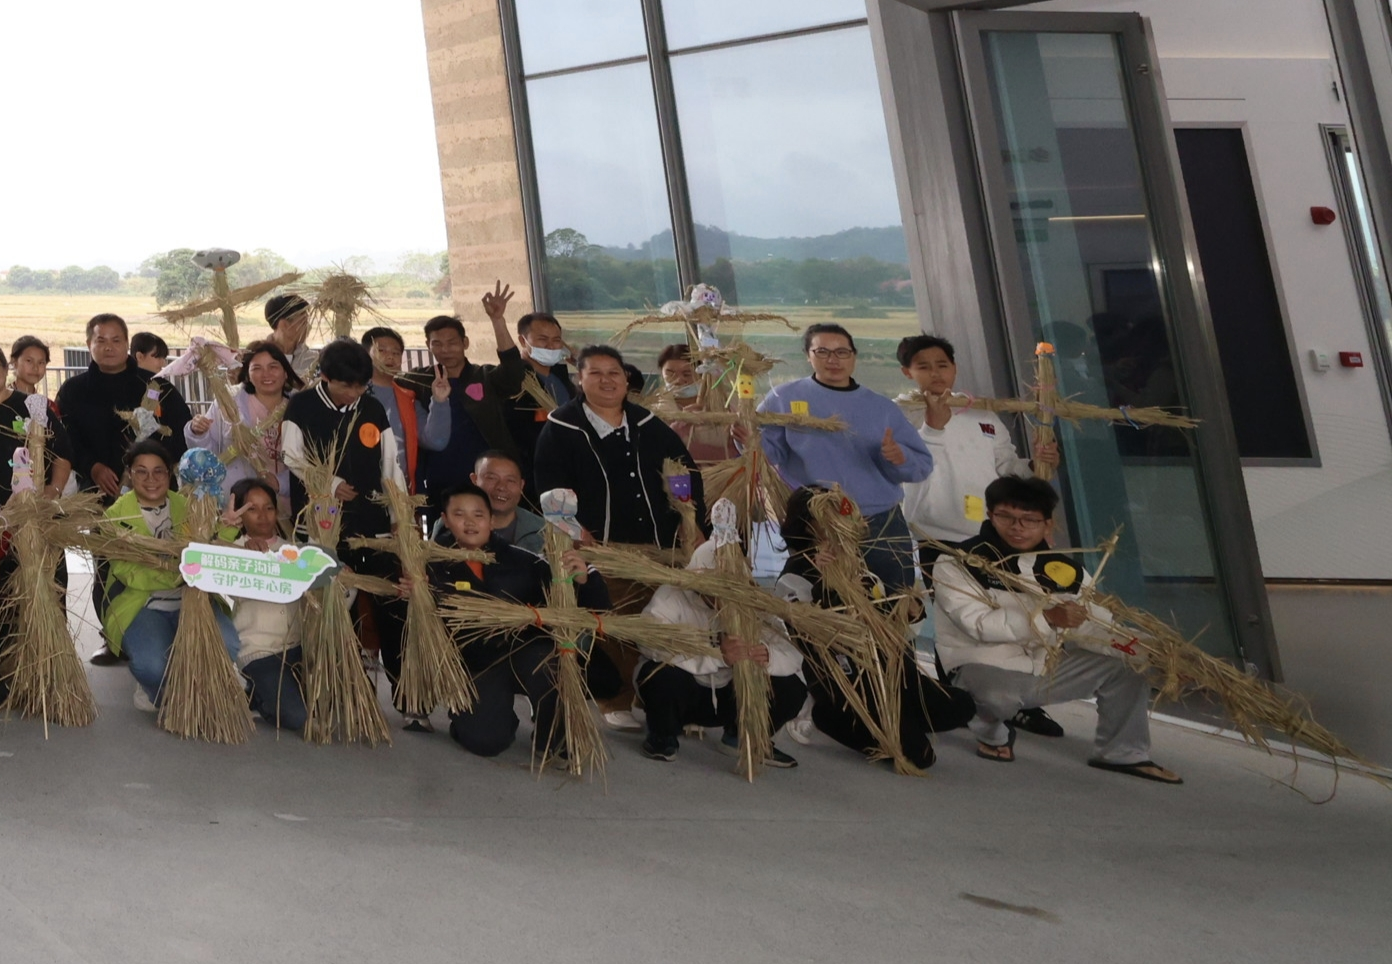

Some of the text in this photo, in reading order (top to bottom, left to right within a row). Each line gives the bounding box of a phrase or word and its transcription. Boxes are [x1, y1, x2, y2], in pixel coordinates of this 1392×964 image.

[201, 553, 281, 576] 解码亲子沟通
[213, 573, 292, 595] 守护少年心房
